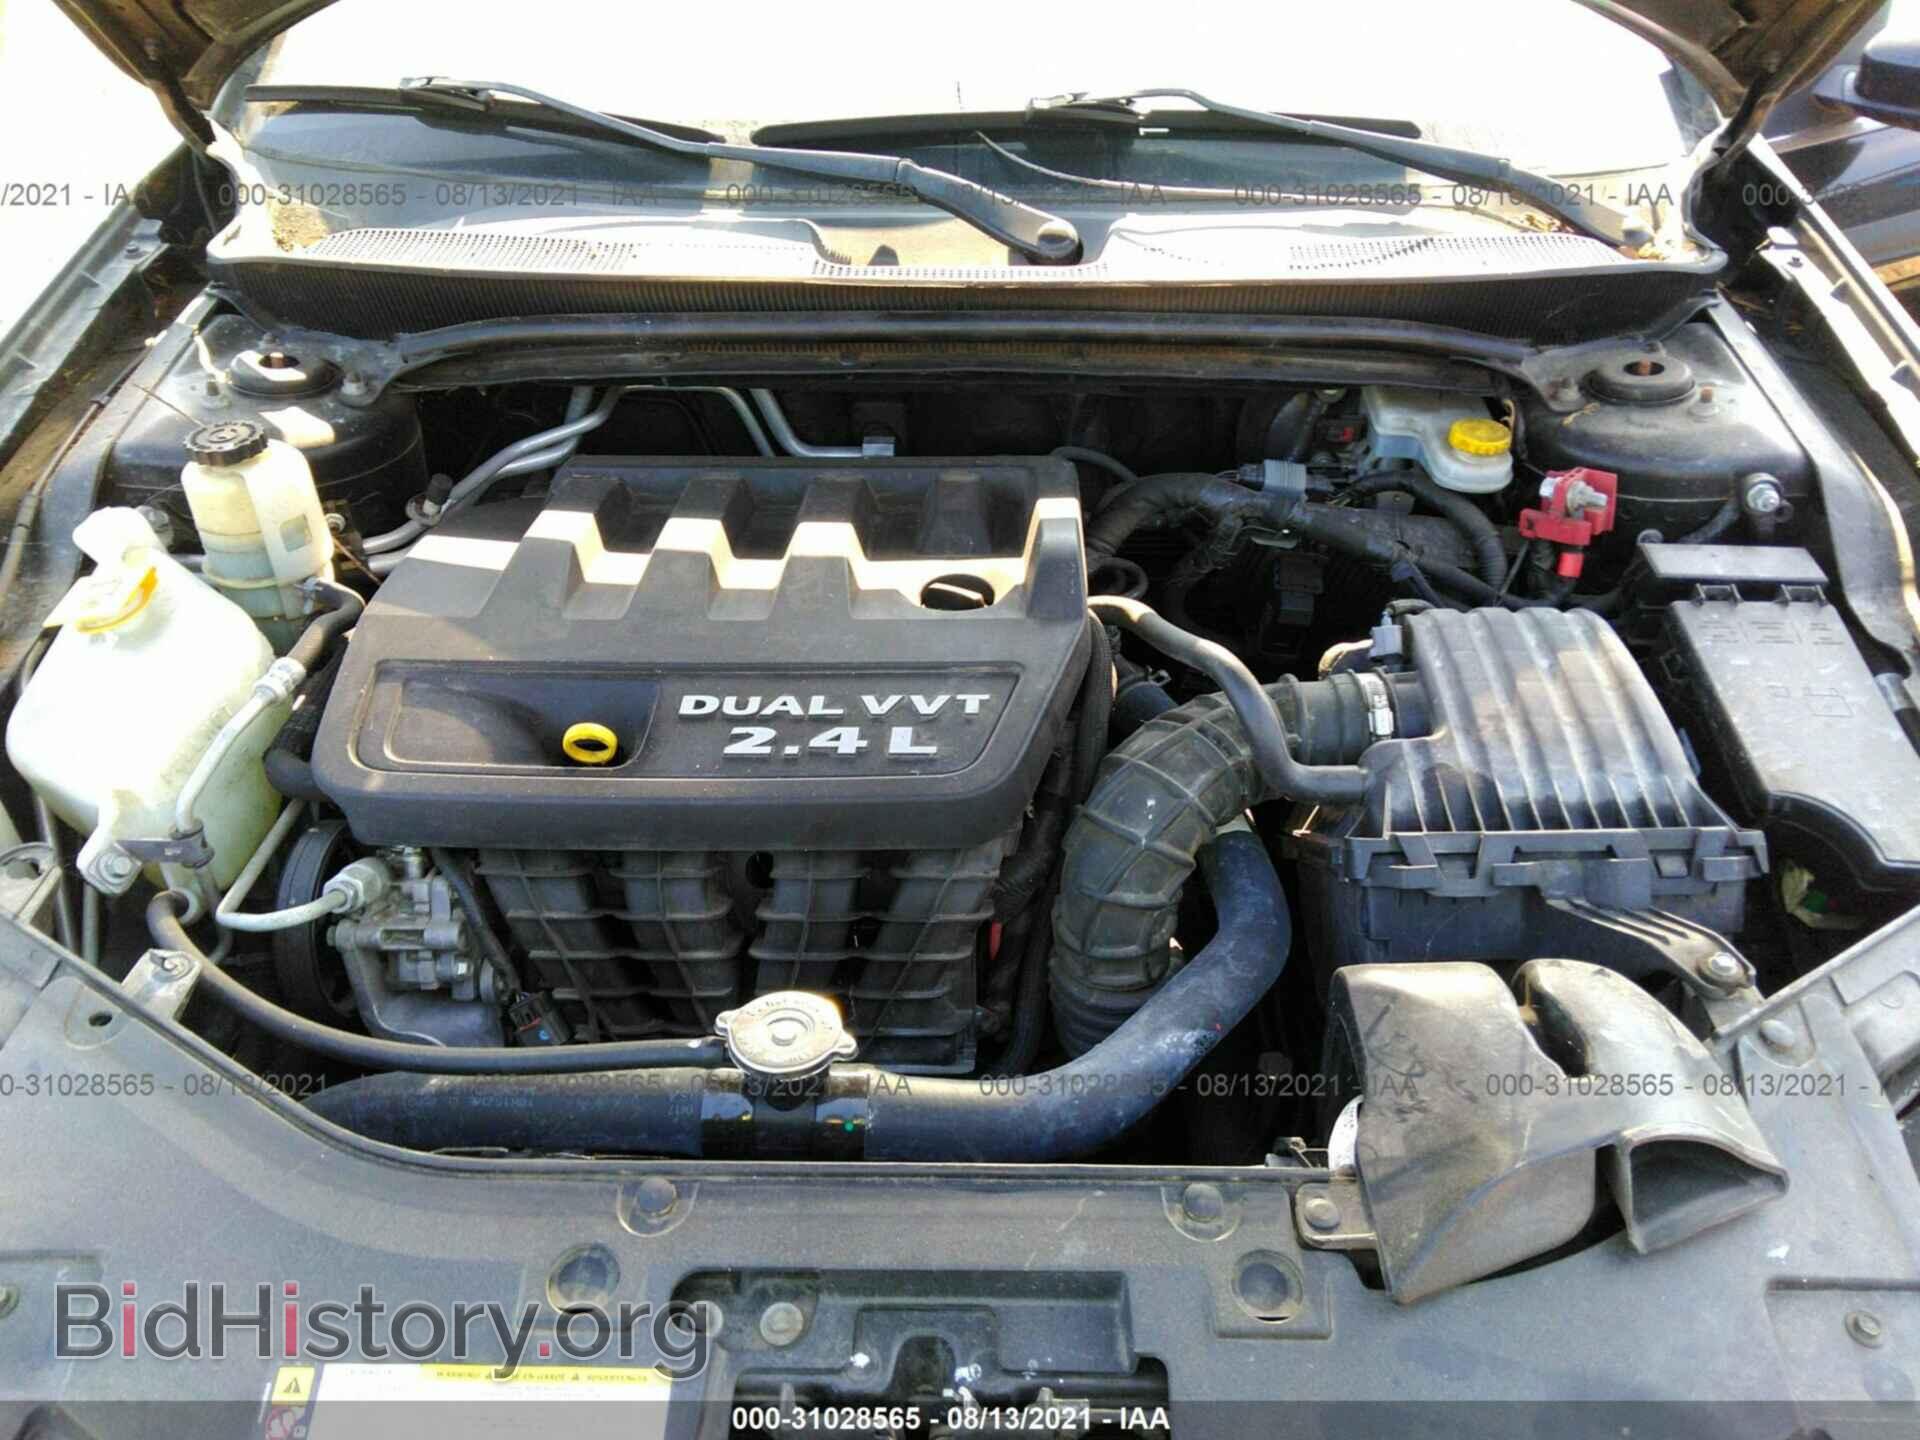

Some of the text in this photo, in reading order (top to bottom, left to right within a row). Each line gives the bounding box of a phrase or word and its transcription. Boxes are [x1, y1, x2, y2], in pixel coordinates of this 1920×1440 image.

[678, 694, 990, 717] DUAL VVT
[723, 726, 938, 757] 2.4 L
